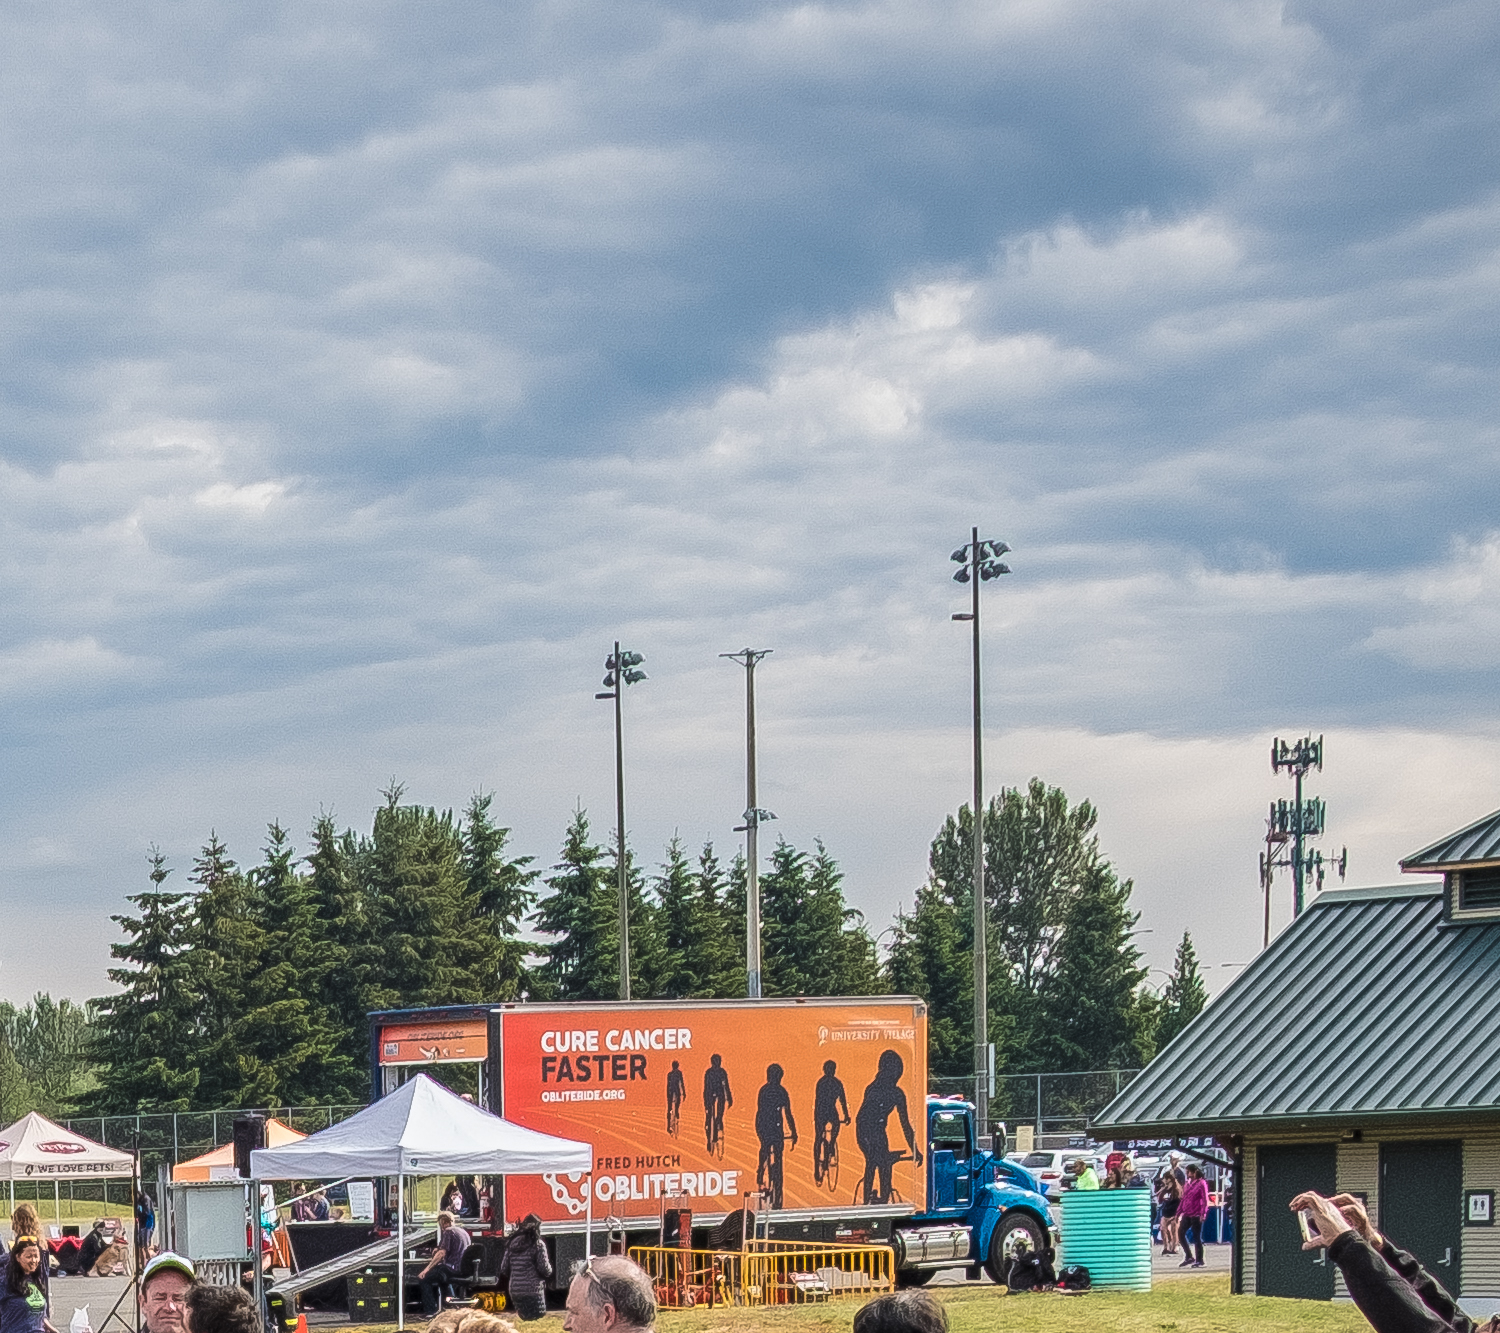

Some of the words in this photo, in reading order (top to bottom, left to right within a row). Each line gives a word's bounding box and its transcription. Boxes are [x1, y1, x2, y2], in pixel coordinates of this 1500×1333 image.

[541, 1030, 599, 1053] CURE
[605, 1028, 692, 1051] CANCER
[541, 1053, 647, 1083] FASTER
[541, 1089, 626, 1103] OBLITERIDE.ORG
[37, 1164, 55, 1174] WE
[57, 1163, 83, 1173] LOVE
[85, 1163, 115, 1173] PETS!
[597, 1157, 631, 1170] FRED
[636, 1154, 681, 1169] HUTCH
[595, 1170, 739, 1201] OBLITERIDE
